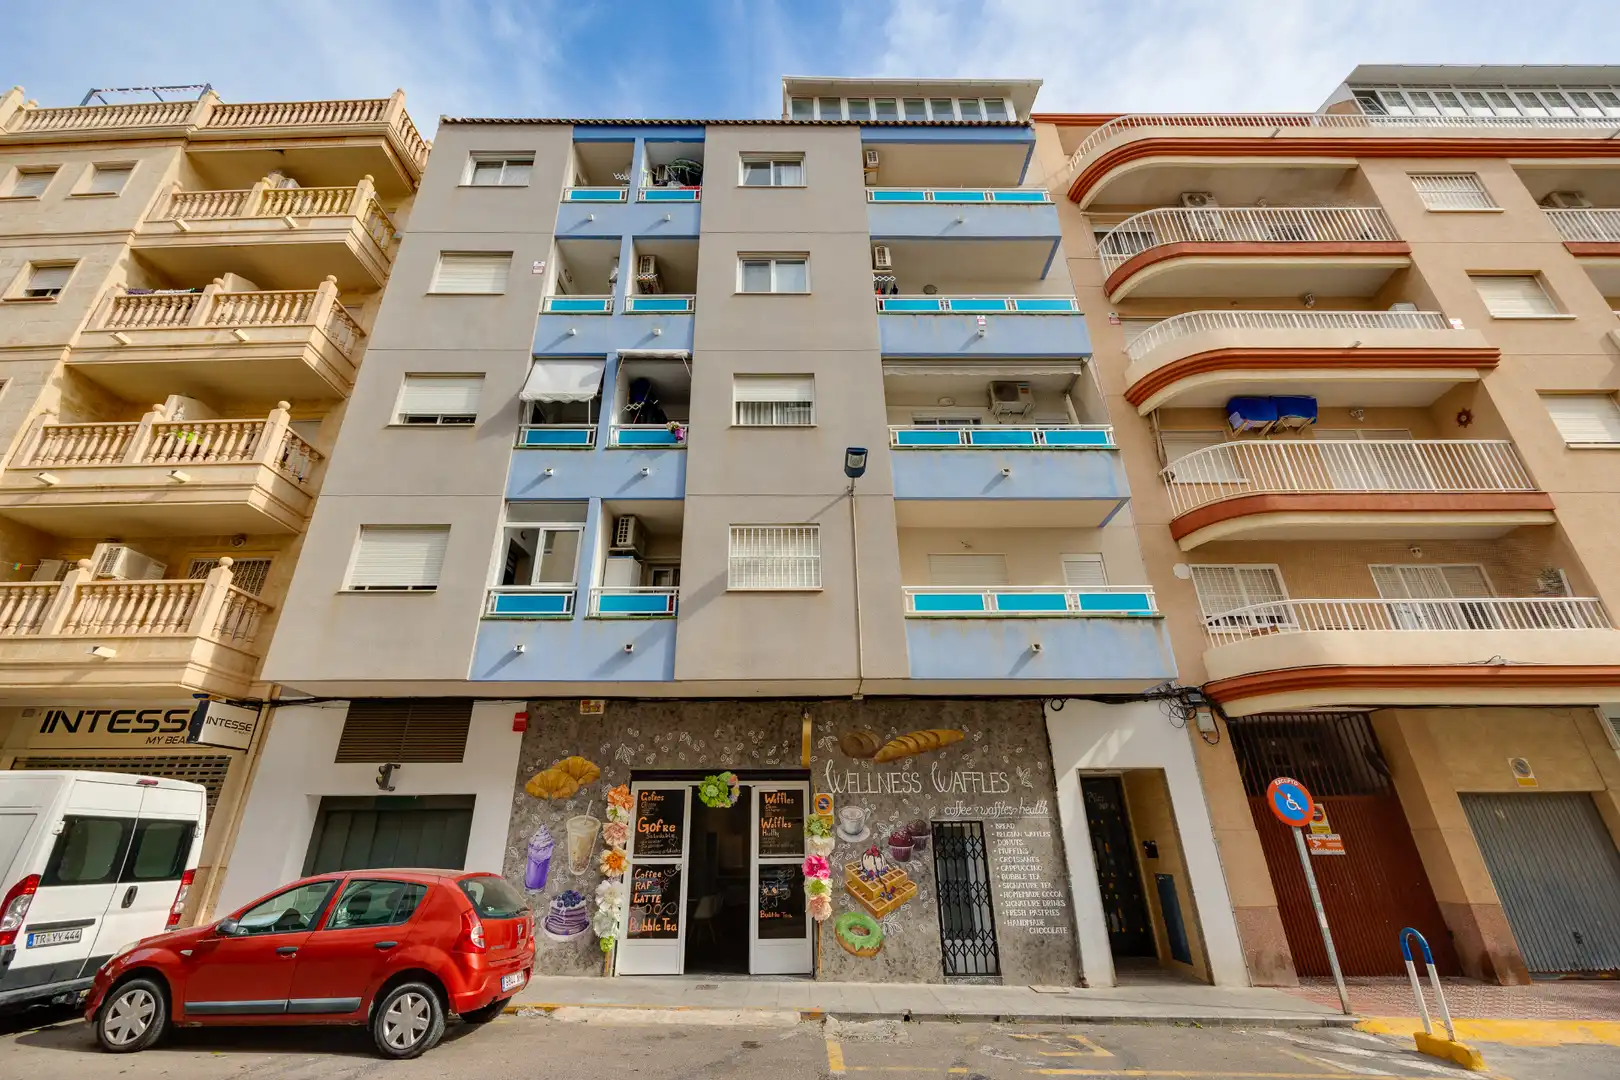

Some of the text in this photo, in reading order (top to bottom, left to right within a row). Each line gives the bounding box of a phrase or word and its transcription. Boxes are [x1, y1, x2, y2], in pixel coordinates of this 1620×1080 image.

[205, 715, 253, 732] INTESSE
[145, 736, 186, 744] MY BEA
[823, 759, 1010, 794] WELLNESS WAFFLES
[765, 792, 795, 804] Waffles
[944, 797, 1049, 817] coffee waffles health
[761, 817, 792, 829] Waffles
[634, 868, 662, 880] Coffee
[1000, 864, 1043, 872] CAPPUCCINO
[635, 880, 652, 891] RAF
[633, 892, 662, 904] LATTE
[629, 916, 678, 933] Bubble Tea
[1007, 919, 1045, 927] HANDMADE
[35, 931, 80, 944] TR YY 444
